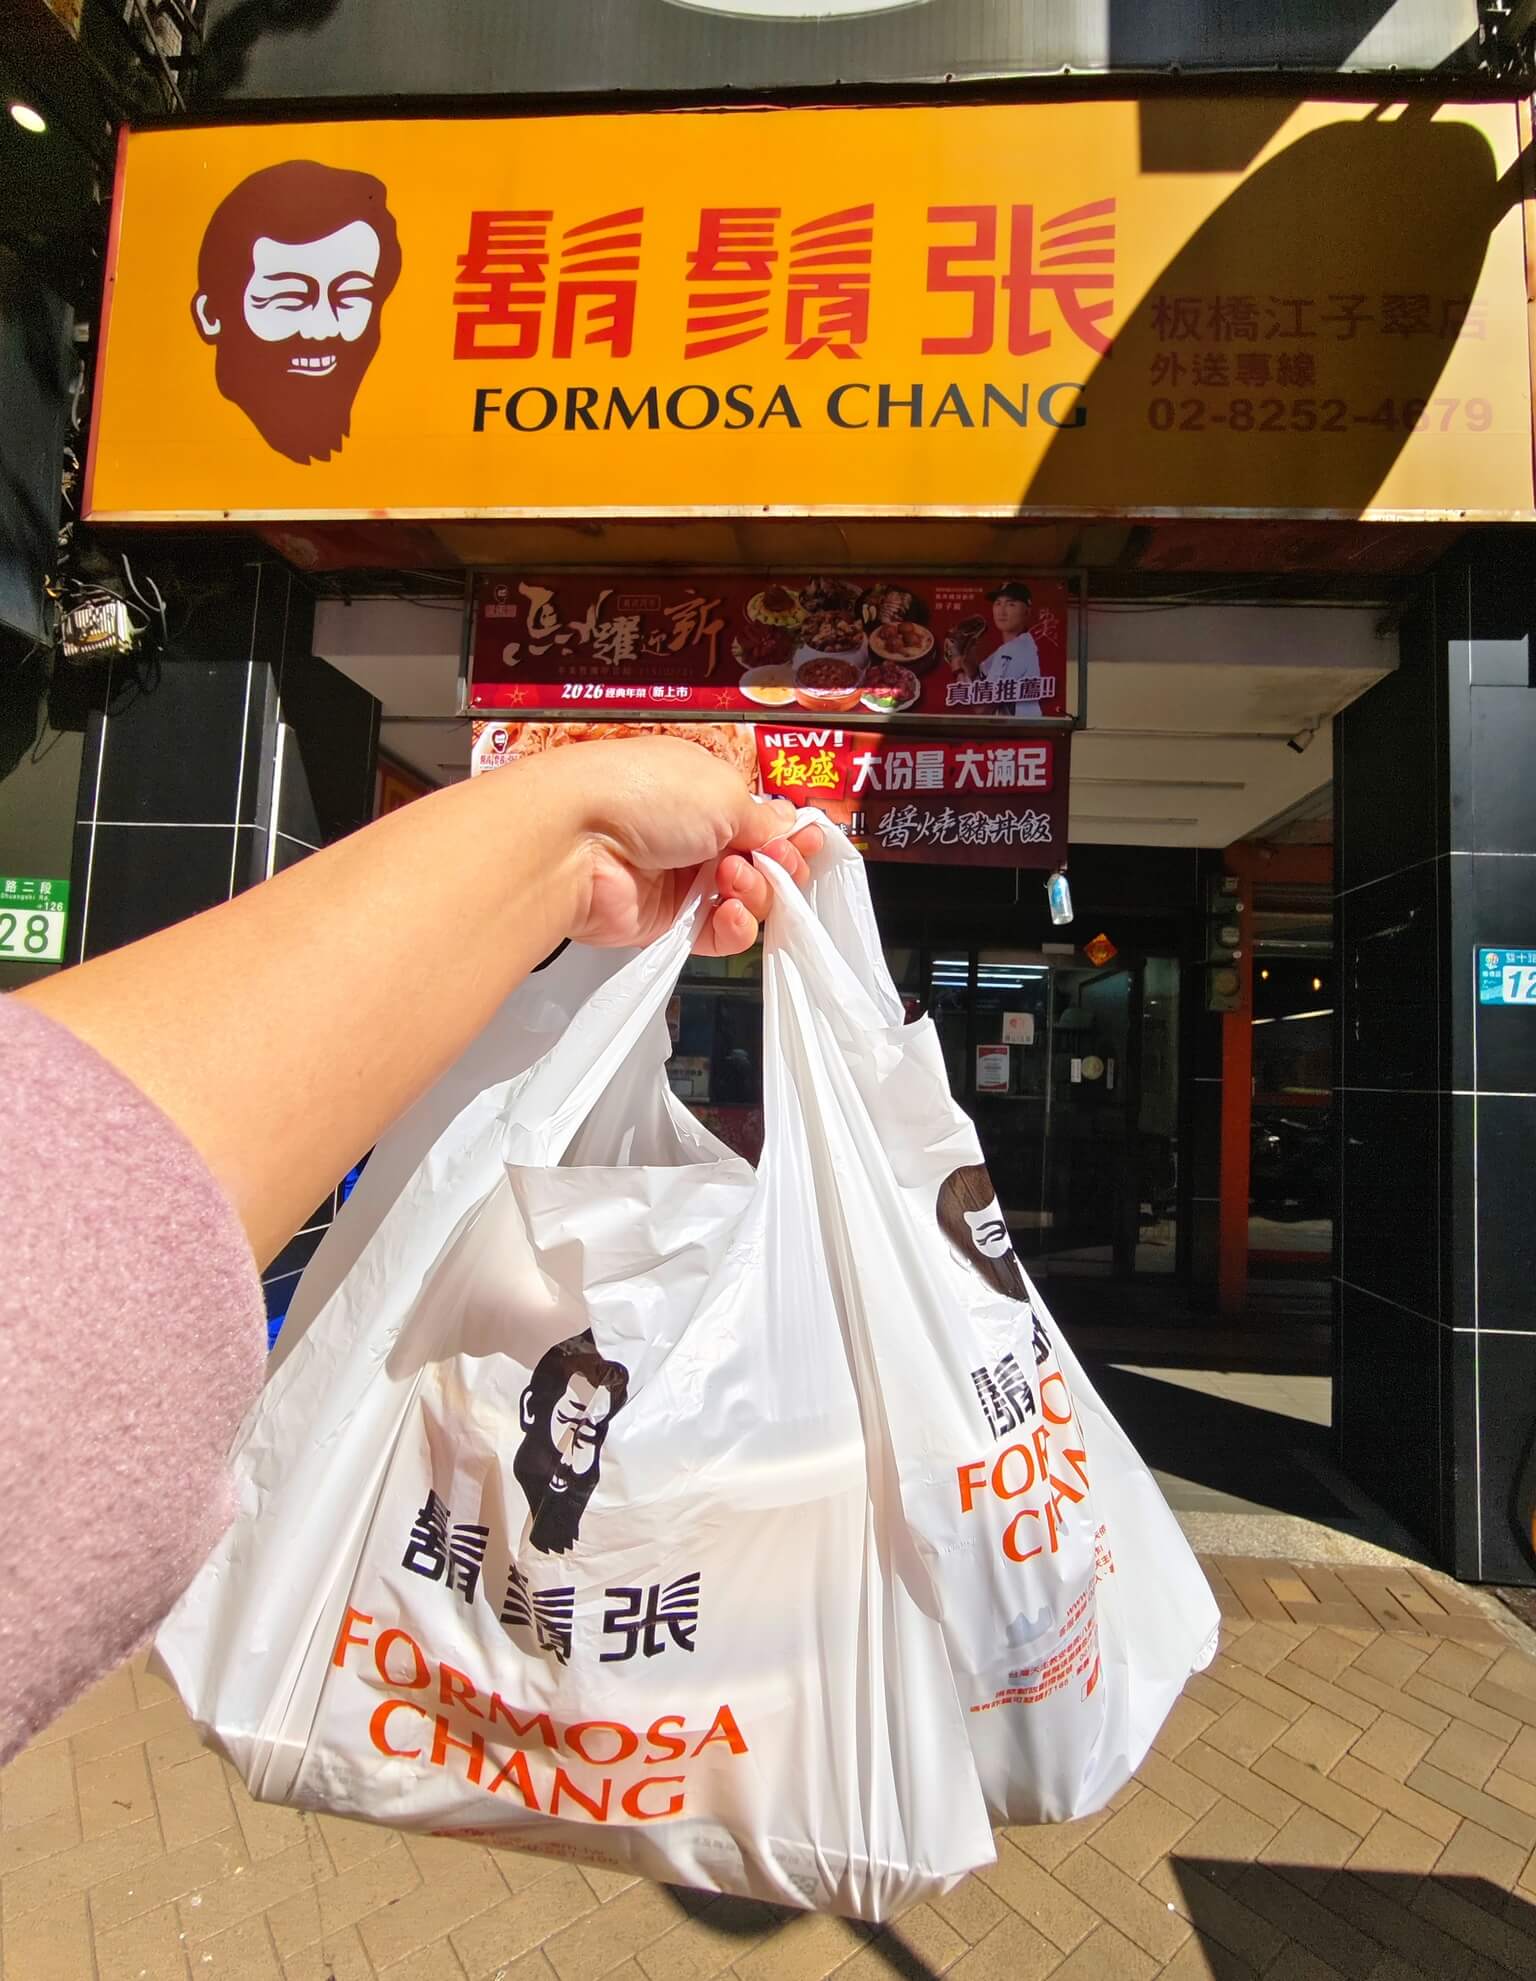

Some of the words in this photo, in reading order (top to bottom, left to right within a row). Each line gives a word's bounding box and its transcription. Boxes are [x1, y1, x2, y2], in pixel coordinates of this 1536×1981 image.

[452, 196, 1118, 361] 鬍鬚張
[1150, 294, 1489, 343] 板橋江子翠店
[1149, 351, 1317, 388] 外送專線
[473, 384, 802, 433] FORMOSA
[825, 381, 1088, 429] CHANG
[561, 683, 605, 700] 2026
[652, 686, 688, 698] 新上市
[764, 730, 845, 749] NEW!
[768, 749, 840, 789] 極盛
[851, 750, 945, 792] 大份量
[954, 747, 1048, 789] 大滿足
[332, 1604, 749, 1767] FORMOSA
[368, 1698, 687, 1823] CHANG
